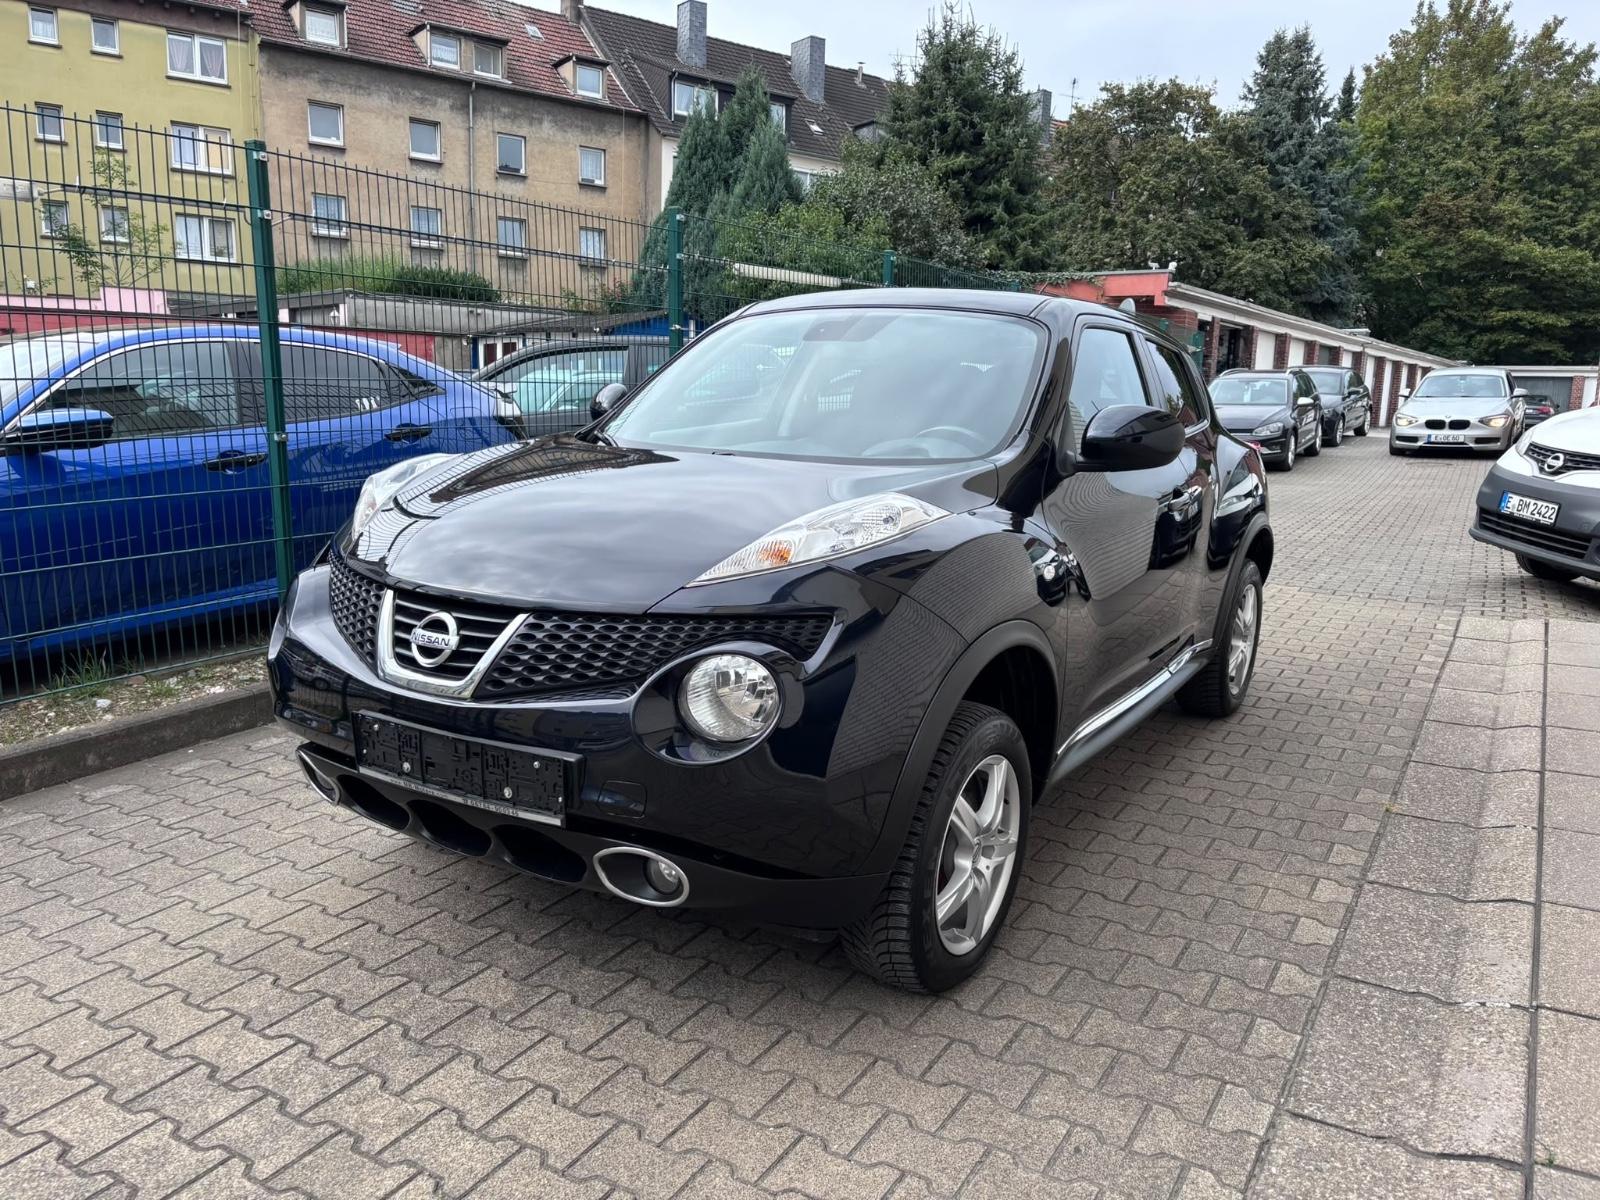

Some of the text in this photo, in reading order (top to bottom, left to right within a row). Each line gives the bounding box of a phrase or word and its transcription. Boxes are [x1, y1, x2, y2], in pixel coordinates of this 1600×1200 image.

[1505, 495, 1513, 509] E
[1516, 499, 1531, 514] BM
[1530, 502, 1556, 520] 2422
[411, 631, 450, 647] NISSAN
